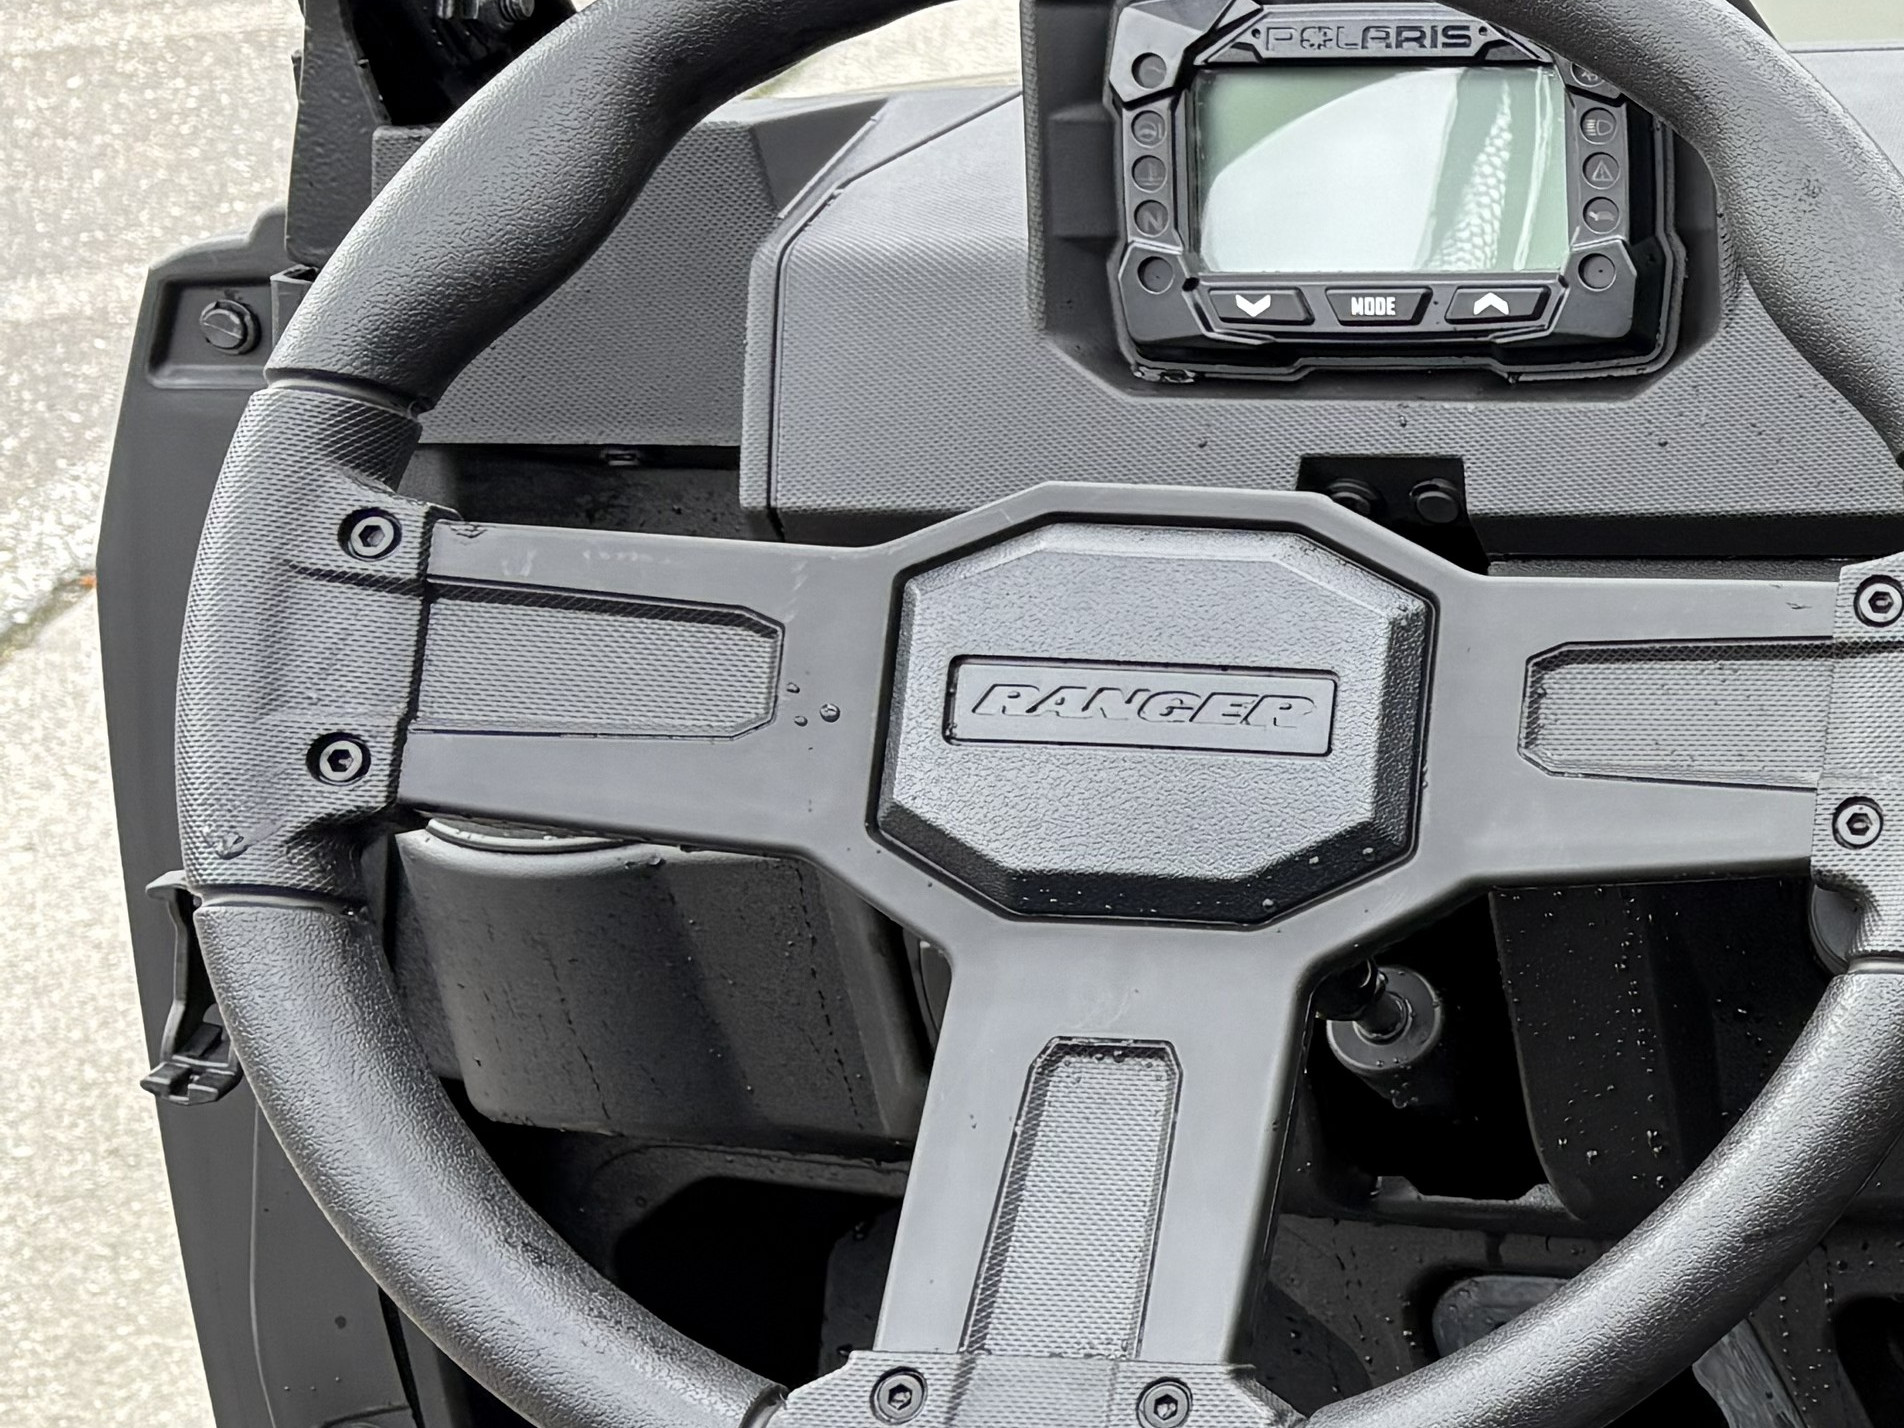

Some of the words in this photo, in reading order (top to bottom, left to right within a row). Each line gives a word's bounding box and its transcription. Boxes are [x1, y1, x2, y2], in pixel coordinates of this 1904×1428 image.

[1265, 25, 1473, 51] POLARIS
[1351, 296, 1396, 316] MODE
[971, 681, 1317, 729] RANGER
